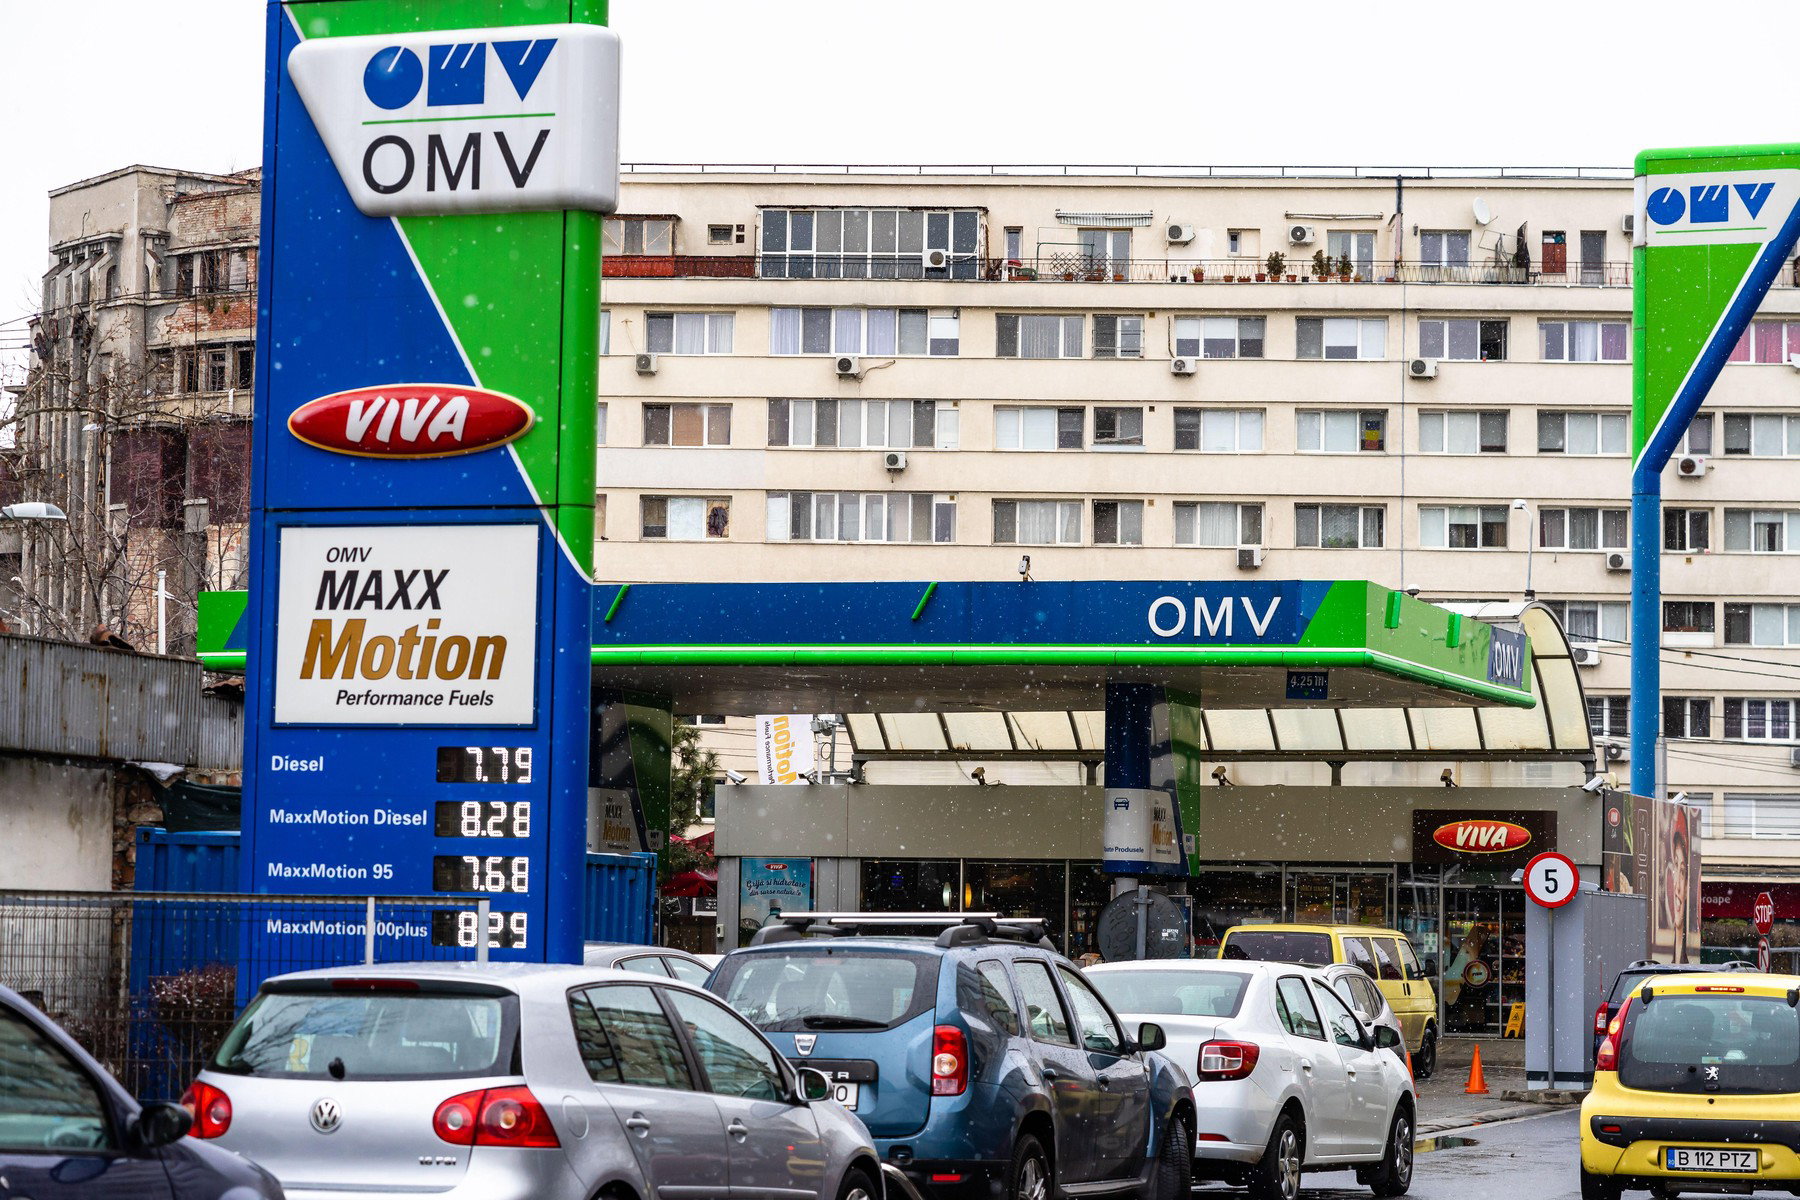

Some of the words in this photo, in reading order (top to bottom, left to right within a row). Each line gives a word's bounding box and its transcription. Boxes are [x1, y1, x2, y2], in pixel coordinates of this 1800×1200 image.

[362, 129, 551, 195] OMV
[345, 394, 470, 443] VIVA
[326, 547, 372, 562] OMV
[315, 569, 450, 610] MAXX
[1147, 595, 1282, 637] OMV
[299, 618, 508, 681] Motion
[1494, 641, 1519, 681] OMV
[1290, 675, 1313, 687] 4.25
[1314, 675, 1325, 687] m
[336, 690, 443, 706] Performance
[448, 689, 494, 706] Fuels
[271, 754, 324, 772] Diesel
[465, 747, 533, 783] 7.79
[269, 808, 369, 825] MaxxMotion
[373, 808, 428, 826] Diesel
[460, 801, 531, 838] 8.28
[1455, 825, 1508, 847] VIVA
[267, 862, 367, 879] MaxxMotion
[372, 863, 394, 880] 95
[462, 856, 529, 893] 7.68
[1544, 869, 1558, 894] 5
[1701, 896, 1731, 906] roape
[1755, 904, 1772, 923] STOP
[267, 919, 366, 936] MaxxMotion
[1678, 1151, 1689, 1166] B
[1694, 1151, 1714, 1166] 112
[1719, 1152, 1751, 1168] PTZ
